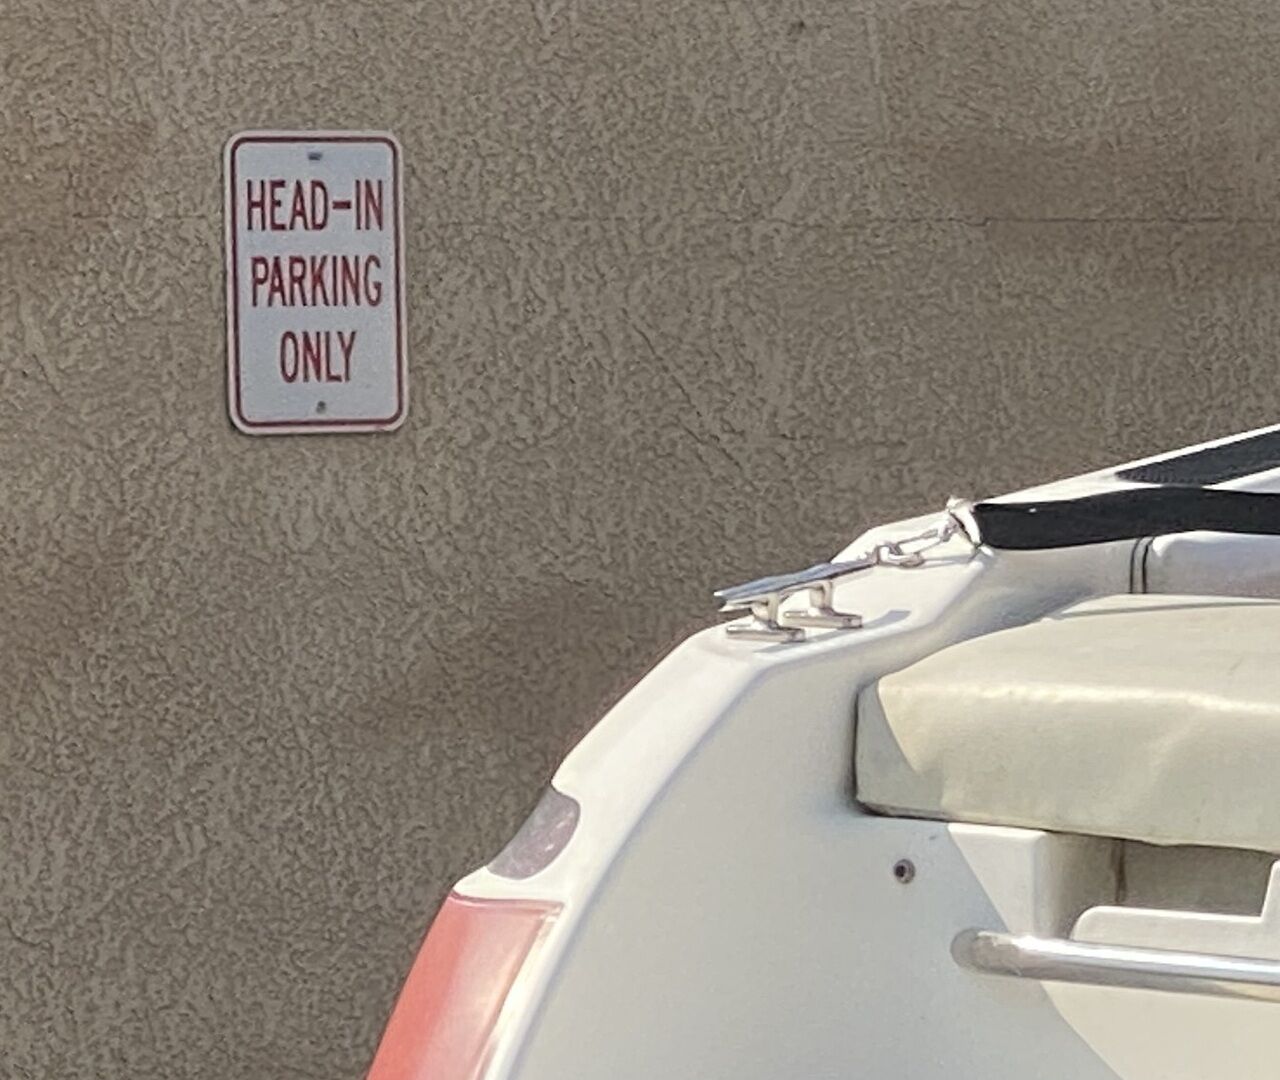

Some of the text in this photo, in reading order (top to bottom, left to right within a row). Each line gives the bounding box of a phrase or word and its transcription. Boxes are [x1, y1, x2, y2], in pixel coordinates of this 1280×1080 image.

[246, 179, 383, 231] HEAD-IN
[251, 254, 382, 307] PARKING
[280, 330, 357, 383] ONLY
